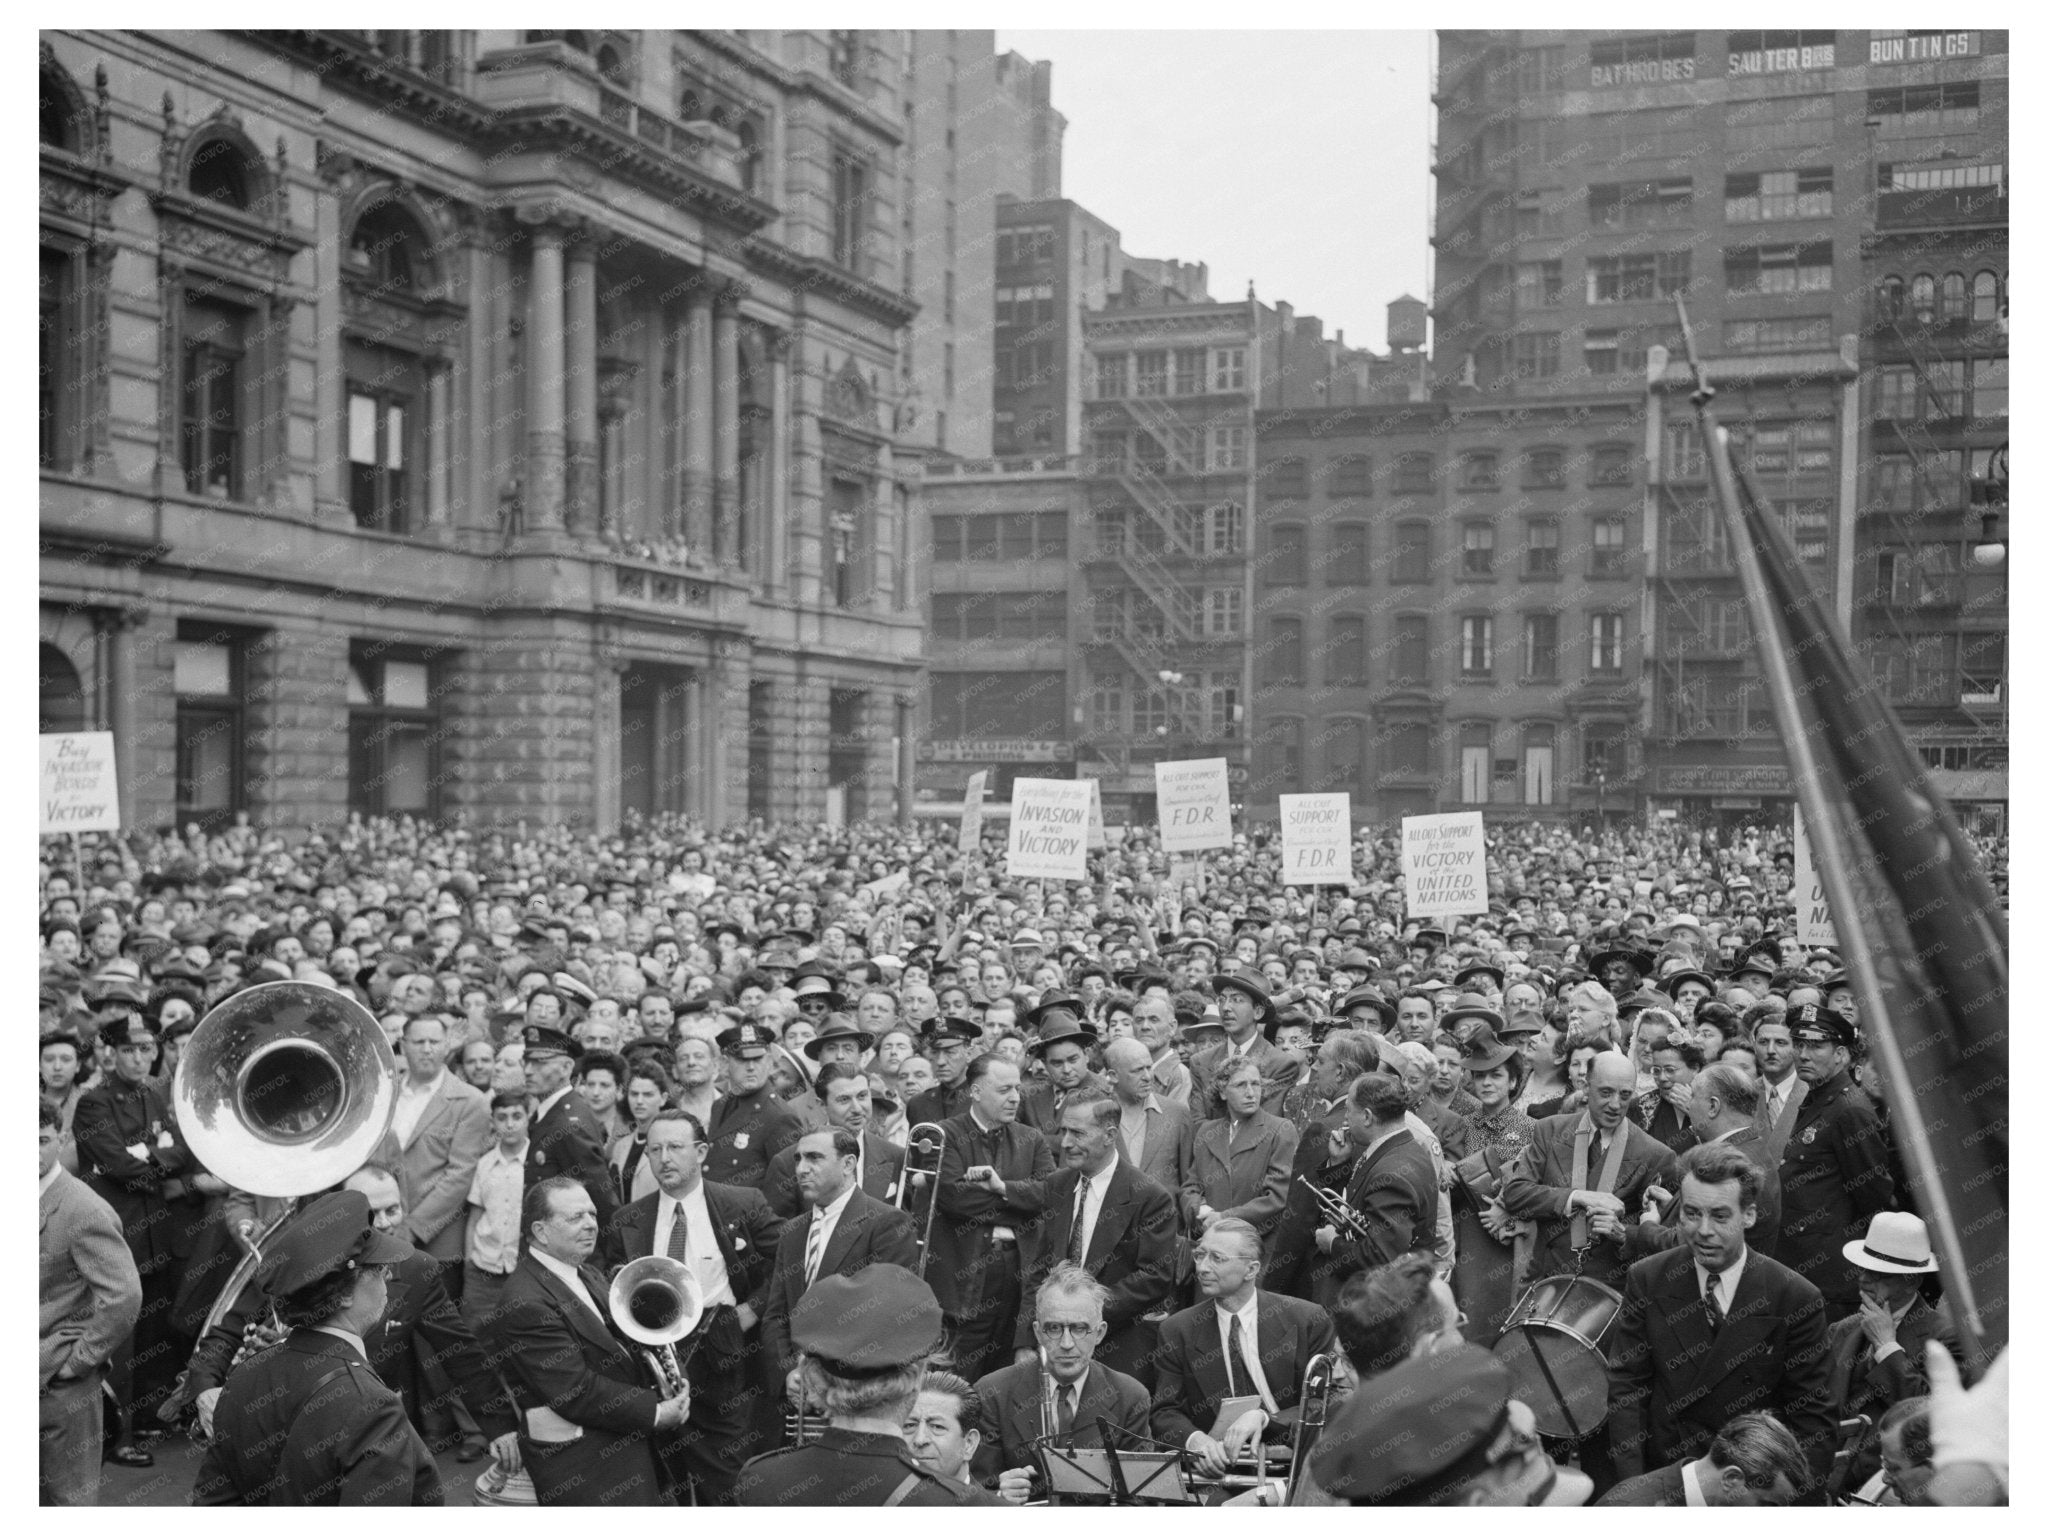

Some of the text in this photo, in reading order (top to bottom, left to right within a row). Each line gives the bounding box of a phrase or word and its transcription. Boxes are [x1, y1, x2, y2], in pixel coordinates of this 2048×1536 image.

[1870, 33, 1968, 63] BUNTINGS
[56, 738, 90, 759] Buy
[47, 798, 107, 823] VICTORY
[1018, 800, 1085, 824] INVASION
[1289, 809, 1341, 825] SUPPORT
[1039, 825, 1063, 834] AND
[1408, 830, 1420, 842] ALL
[1422, 828, 1437, 840] OUT
[1018, 829, 1080, 856] VICTORY
[1426, 840, 1455, 854] for the
[1413, 850, 1475, 868] VICTORY
[1416, 874, 1472, 891] UNITED
[1417, 888, 1477, 904] NATIONS
